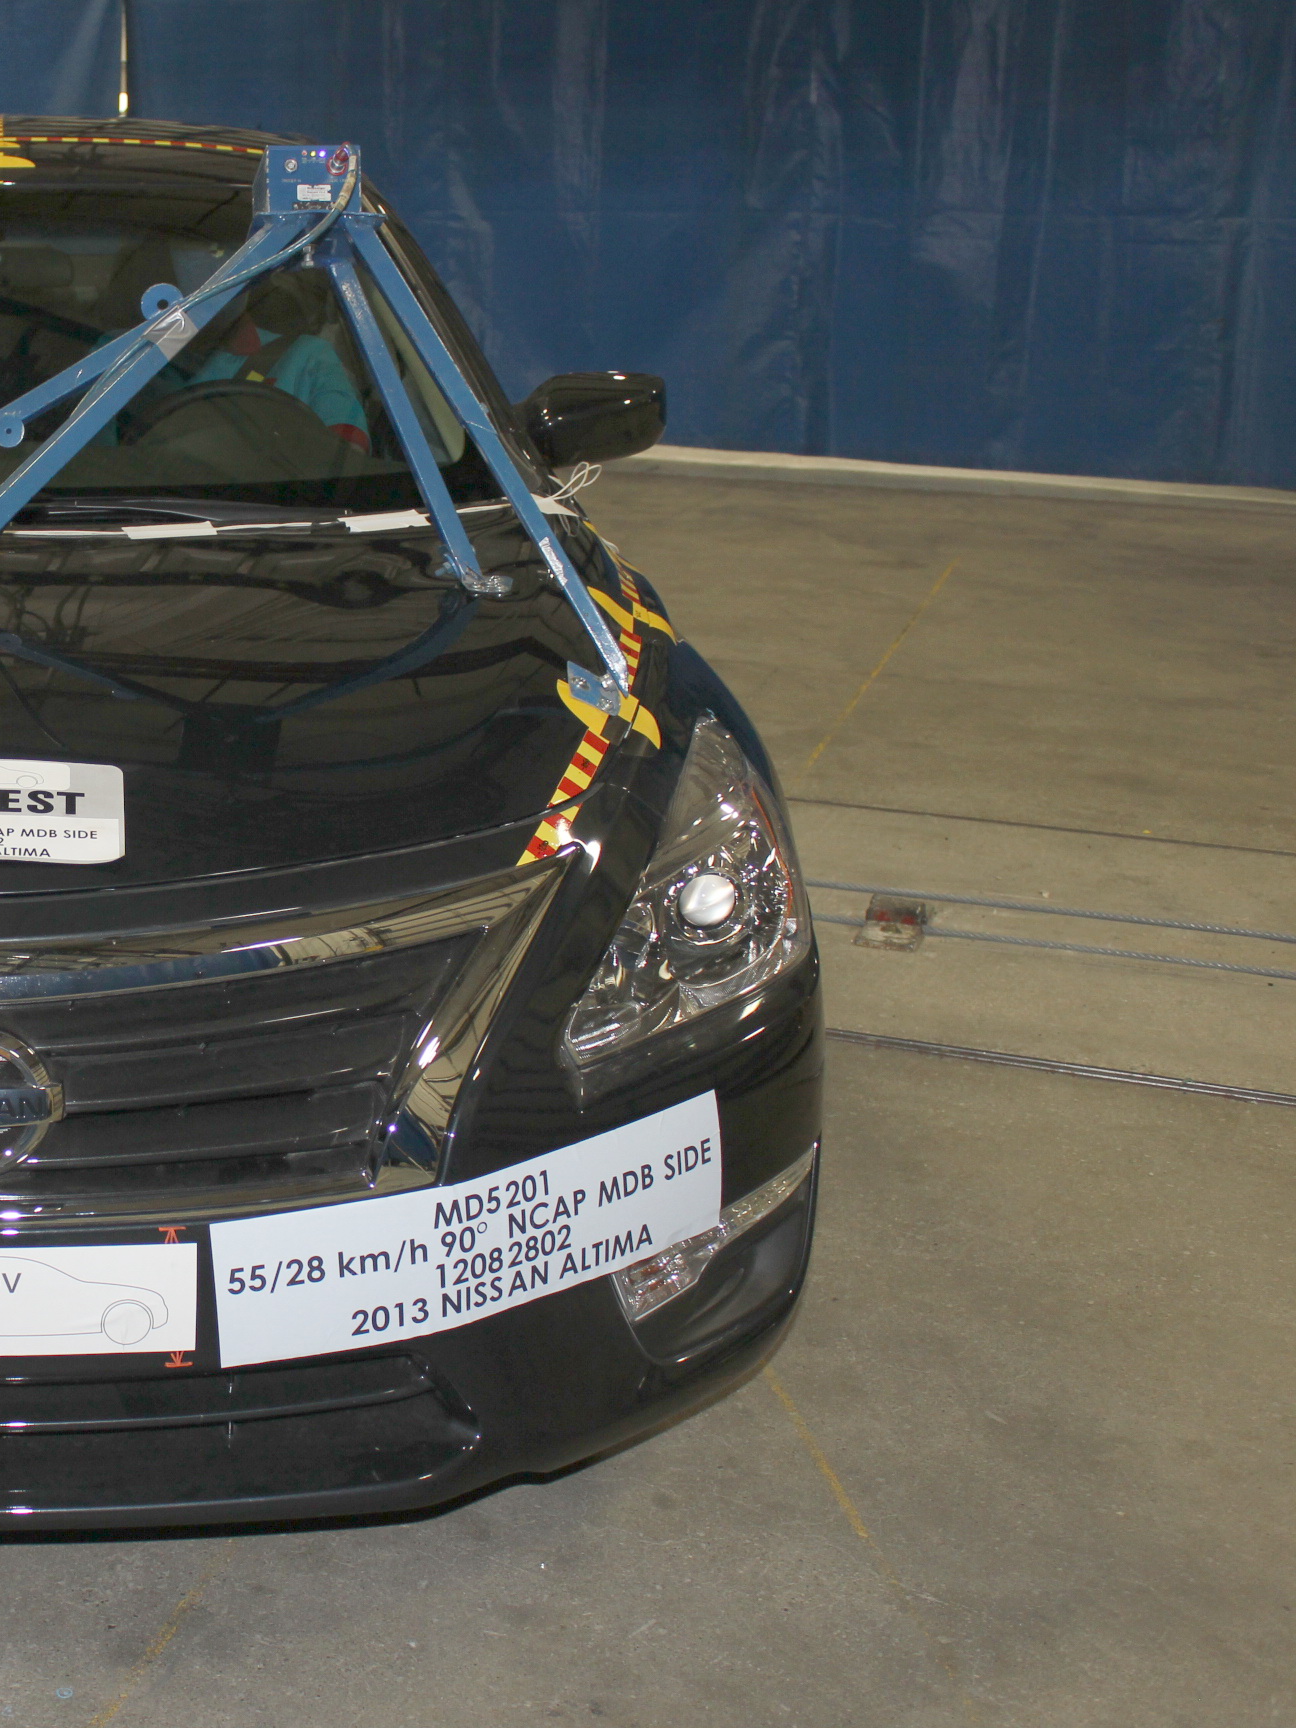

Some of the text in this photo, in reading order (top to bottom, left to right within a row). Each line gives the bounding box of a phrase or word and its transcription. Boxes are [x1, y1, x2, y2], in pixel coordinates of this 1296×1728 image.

[20, 828, 58, 838] MDB
[63, 829, 98, 839] SIDE
[227, 1255, 326, 1295] 55/28
[337, 1238, 429, 1278] km/h
[508, 1188, 587, 1239] NCAP
[598, 1163, 654, 1208] MDB
[663, 1137, 712, 1181] SIDE
[433, 1169, 550, 1230] MD5201
[351, 1223, 653, 1337] 2013 NISSAN ALTIMA
[435, 1223, 572, 1289] 12082802
